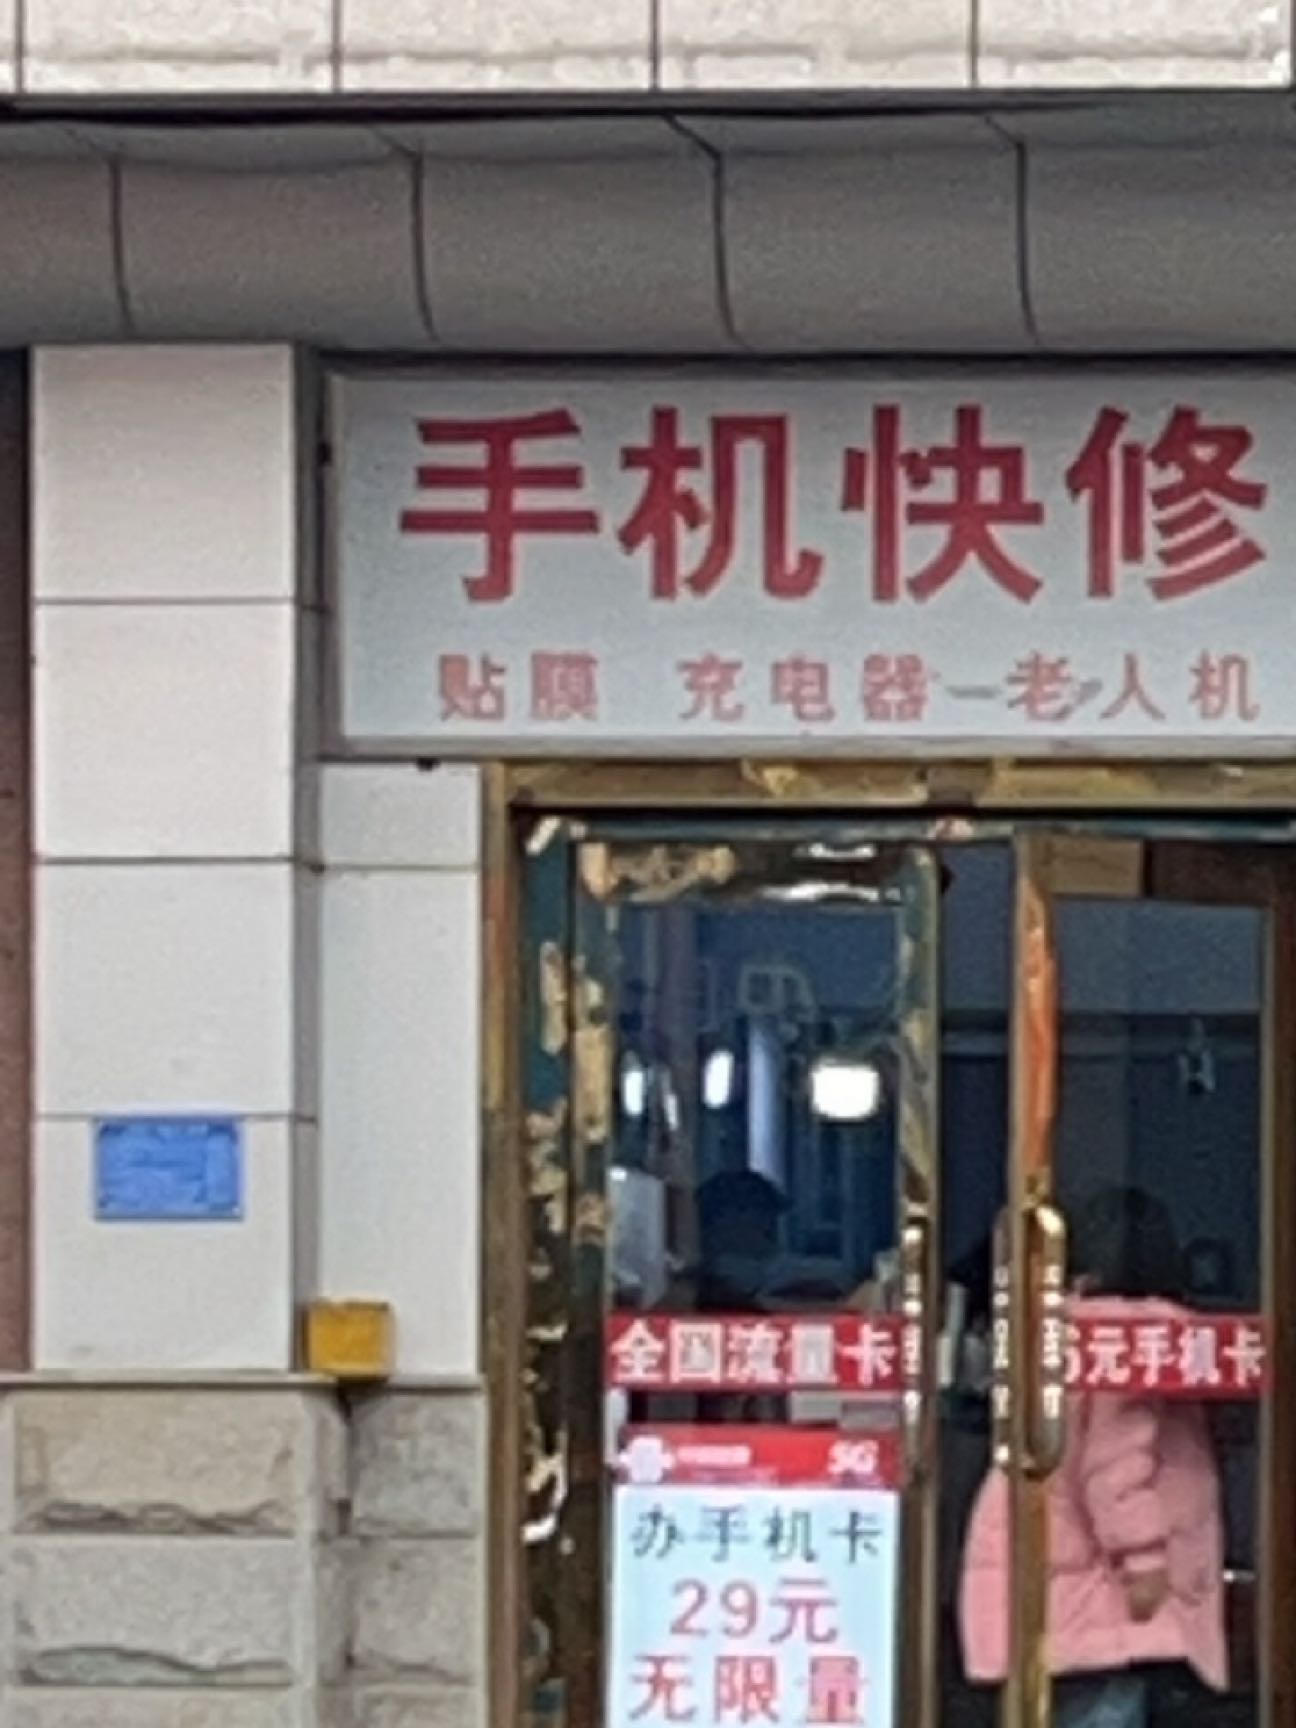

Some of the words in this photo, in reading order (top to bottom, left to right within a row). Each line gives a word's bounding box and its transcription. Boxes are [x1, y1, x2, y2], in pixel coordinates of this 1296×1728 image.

[400, 405, 1269, 603] 手机快修
[437, 651, 600, 722] 贴膜
[676, 653, 930, 722] 充电器
[1006, 652, 1260, 722] 老人机
[611, 1322, 897, 1387] 全国流量卡
[630, 1504, 884, 1563] 办手机卡
[669, 1577, 840, 1645] 29元
[627, 1653, 865, 1727] 无限量
